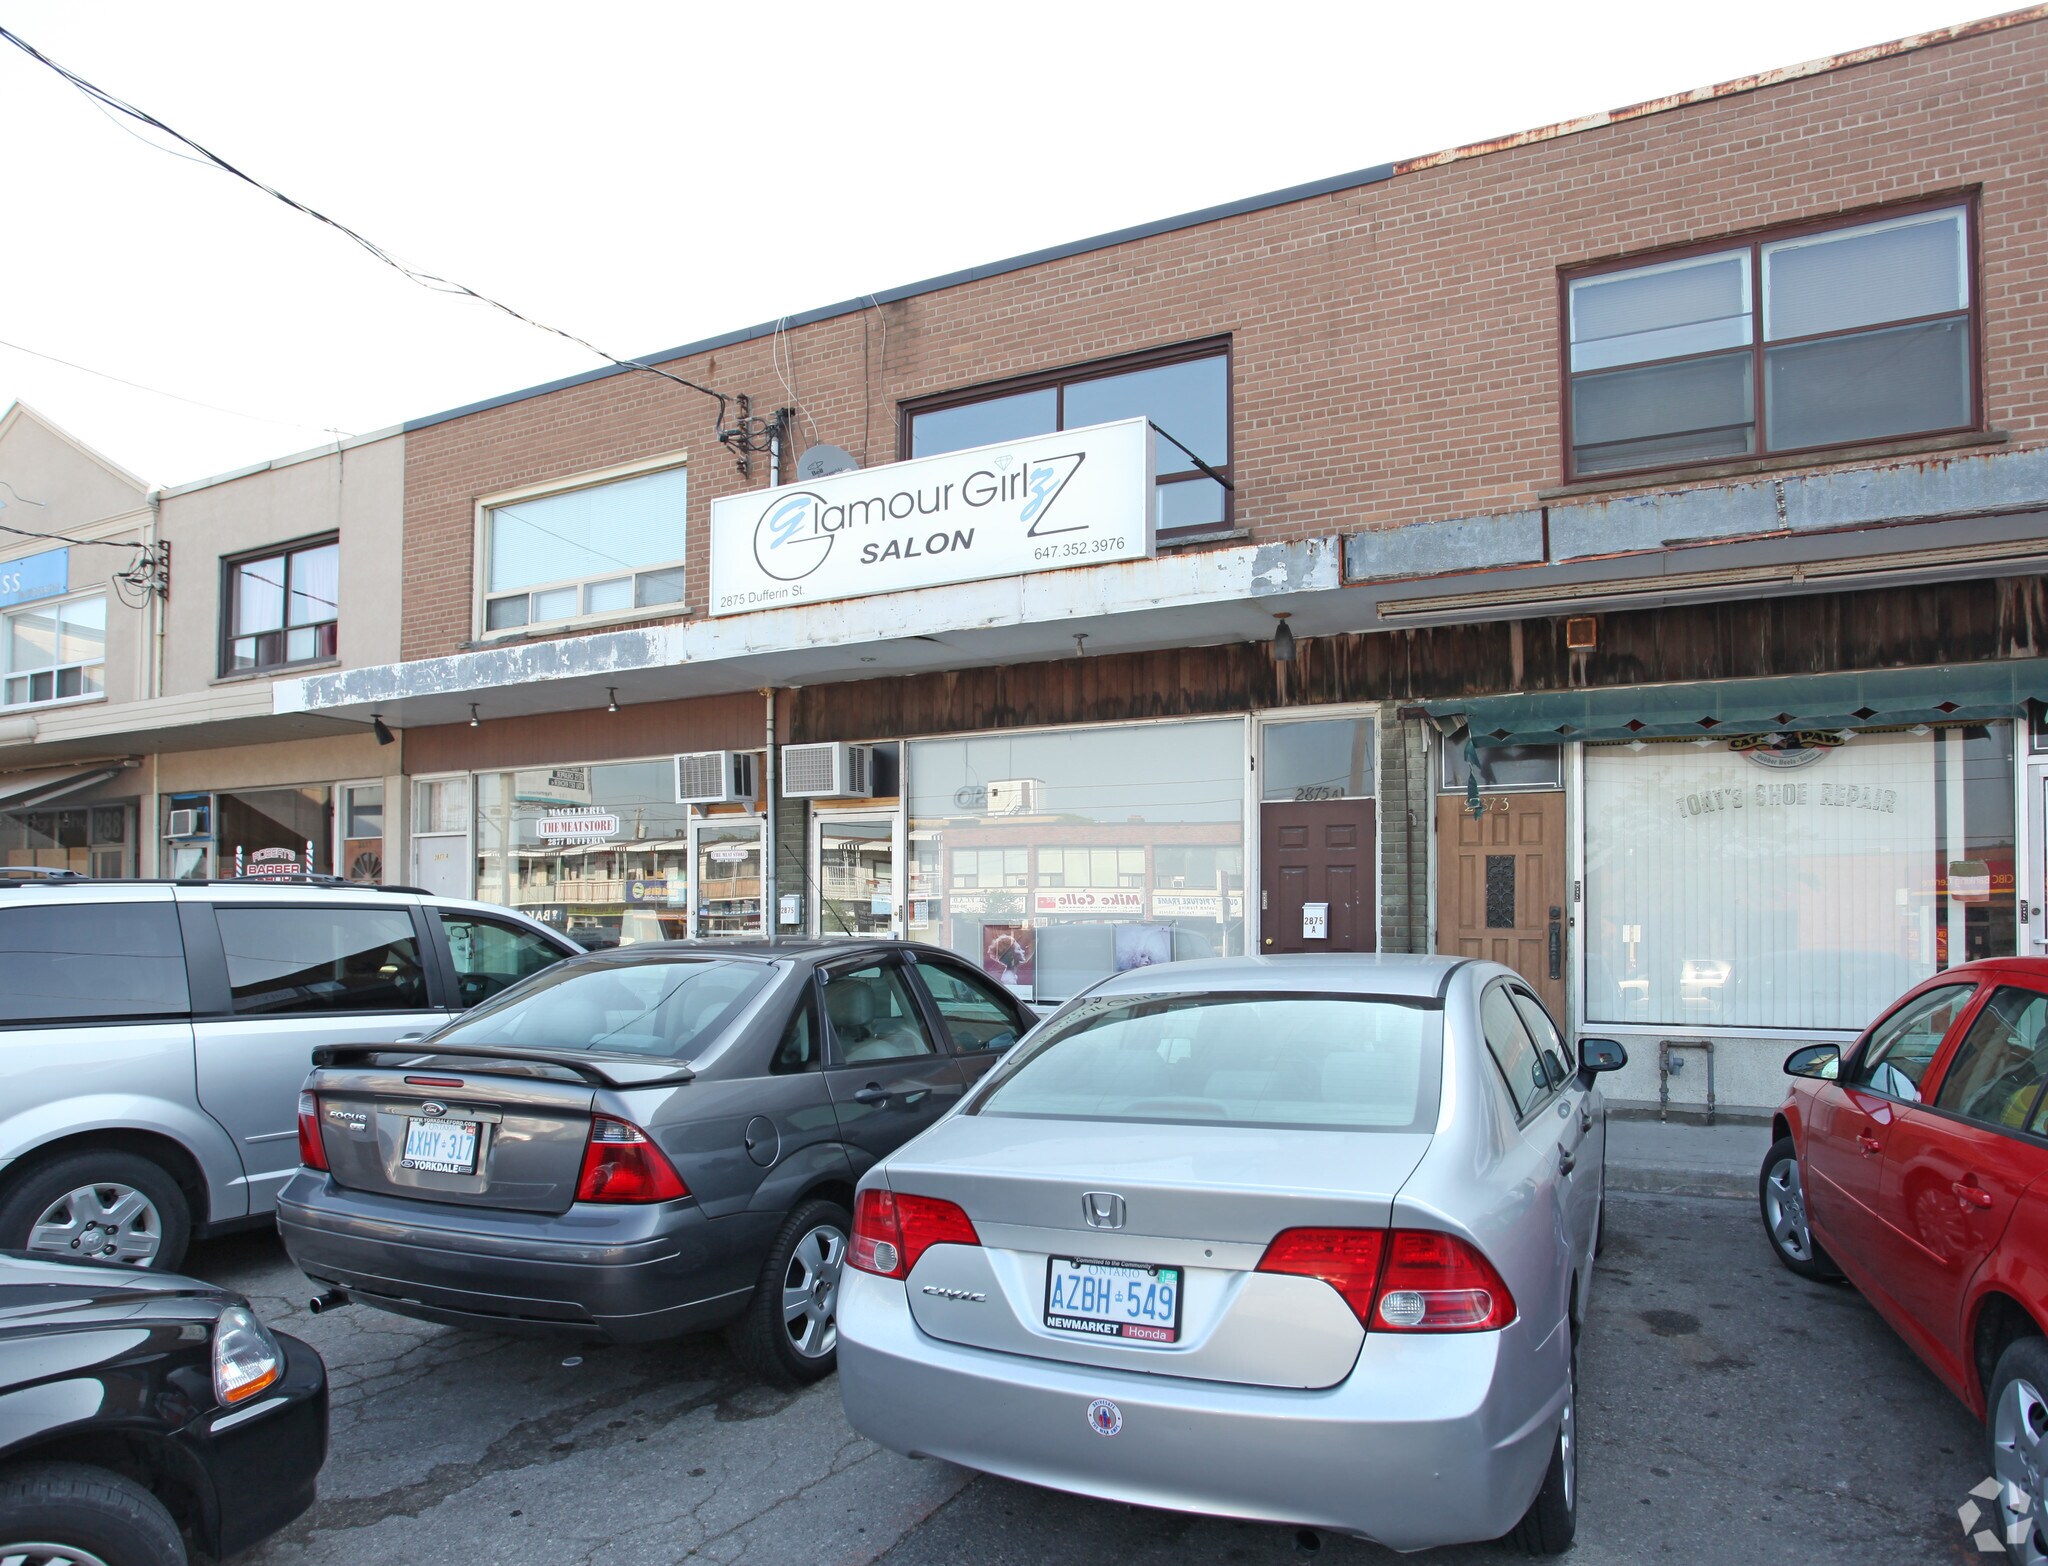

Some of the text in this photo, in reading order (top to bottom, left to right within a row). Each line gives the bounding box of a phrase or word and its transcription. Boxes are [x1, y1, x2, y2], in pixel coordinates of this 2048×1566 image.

[754, 483, 953, 581] Glamour
[860, 528, 975, 564] SALON
[1034, 537, 1125, 560] 647.352.3976
[721, 585, 805, 607] 2875 Dufferin St.
[1802, 731, 1841, 743] PAW
[1295, 786, 1329, 800] 2875
[1676, 783, 1898, 818] TONY'S SHOE REPAIR
[548, 806, 606, 817] MACELLERIA
[543, 819, 612, 833] THE MEAT STORE
[548, 836, 606, 846] 2877 DUFFERIN
[252, 847, 296, 862] ROBERT'S
[247, 863, 300, 876] BARBER
[1304, 917, 1323, 925] 2875
[1311, 925, 1316, 933] A
[329, 1110, 367, 1122] FOCUS
[409, 1116, 477, 1127] WWW.YORKDALEFORD.COM
[407, 1130, 474, 1161] AXHY 317
[414, 1160, 459, 1174] YORKDALE
[1088, 1264, 1140, 1279] ONTARIO
[923, 1286, 987, 1303] CIVIC
[1051, 1274, 1174, 1321] AZBH 549
[1047, 1316, 1167, 1340] NEWMARKET Honda
